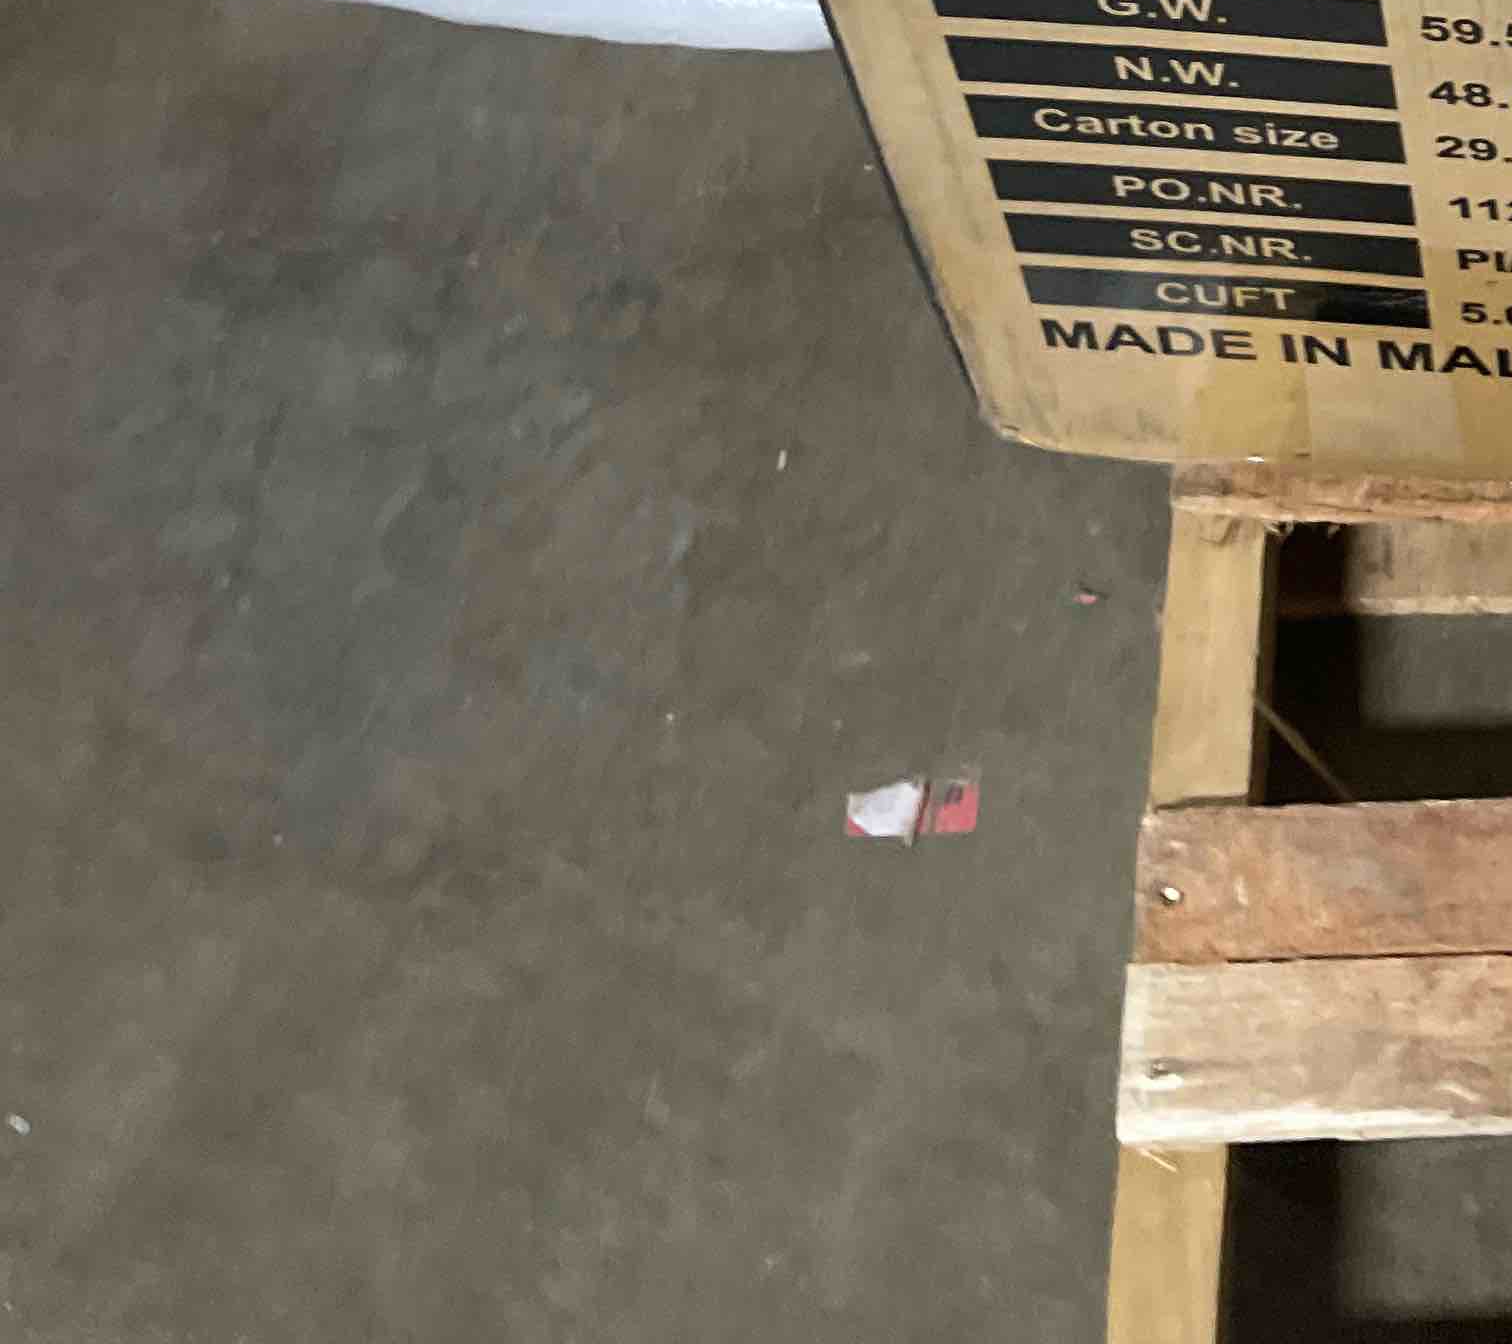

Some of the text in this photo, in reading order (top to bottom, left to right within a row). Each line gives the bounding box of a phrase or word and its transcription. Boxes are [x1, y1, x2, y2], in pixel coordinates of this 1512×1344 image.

[1114, 55, 1239, 88] N.W.
[1034, 108, 1215, 141] Carton
[1233, 122, 1339, 150] size
[1113, 175, 1302, 209] PO.NR.
[1130, 228, 1312, 261] SC.NR.
[1155, 281, 1295, 310] CUFT
[1040, 318, 1257, 361] MADE
[1281, 332, 1351, 367] IN
